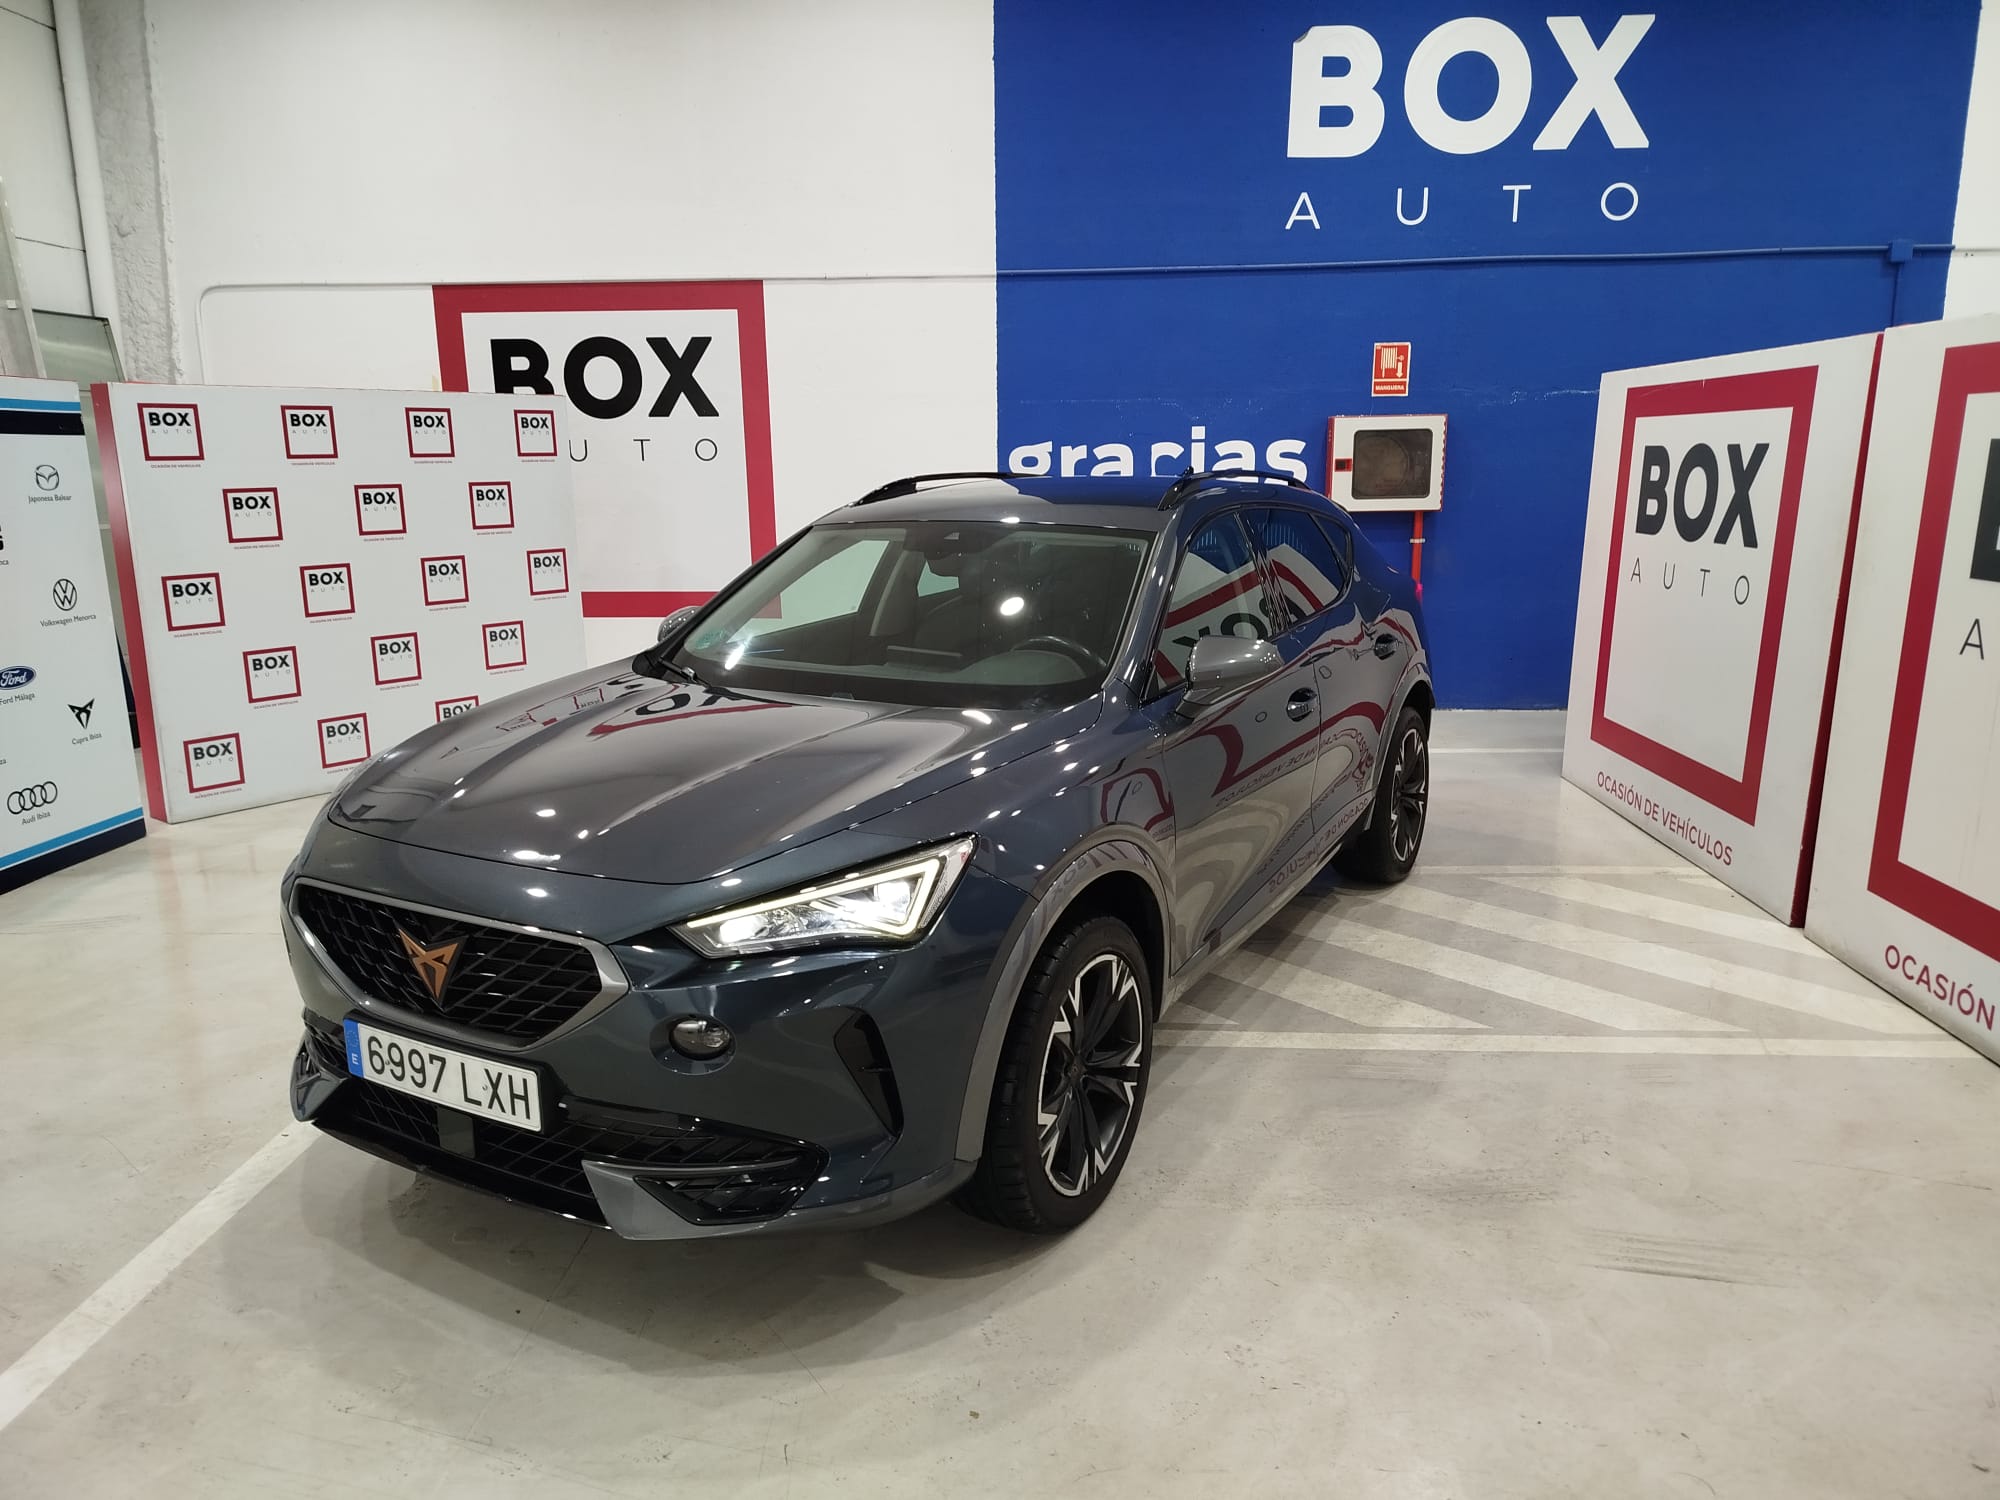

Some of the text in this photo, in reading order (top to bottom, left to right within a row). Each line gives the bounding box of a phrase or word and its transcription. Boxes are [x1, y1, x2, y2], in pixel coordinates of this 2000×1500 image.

[1287, 13, 1655, 158] BOX
[1285, 182, 1638, 229] AUTO
[490, 336, 719, 419] BOX
[148, 412, 191, 426] BOX
[290, 413, 326, 427] BOX
[413, 415, 445, 428] BOX
[521, 417, 549, 429] BOX
[569, 438, 718, 462] UTO
[363, 492, 396, 505] BOX
[476, 488, 506, 501] BOX
[1635, 443, 1769, 549] BOX
[232, 496, 271, 510] BOX
[429, 563, 459, 576] BOX
[533, 556, 560, 568] BOX
[309, 571, 344, 586] BOX
[1630, 557, 1750, 605] AUTO
[172, 582, 212, 597] BOX
[489, 628, 518, 642] BOX
[379, 640, 412, 655] BOX
[252, 655, 289, 671] BOX
[1, 670, 27, 686] Ford
[326, 721, 360, 738] BOX
[193, 742, 232, 760] BOX
[1597, 771, 1733, 866] OCASIÓN DE VEHÍCULOS
[1884, 945, 1995, 1031] OCASIÓN
[367, 1035, 531, 1120] 6997 LXH
